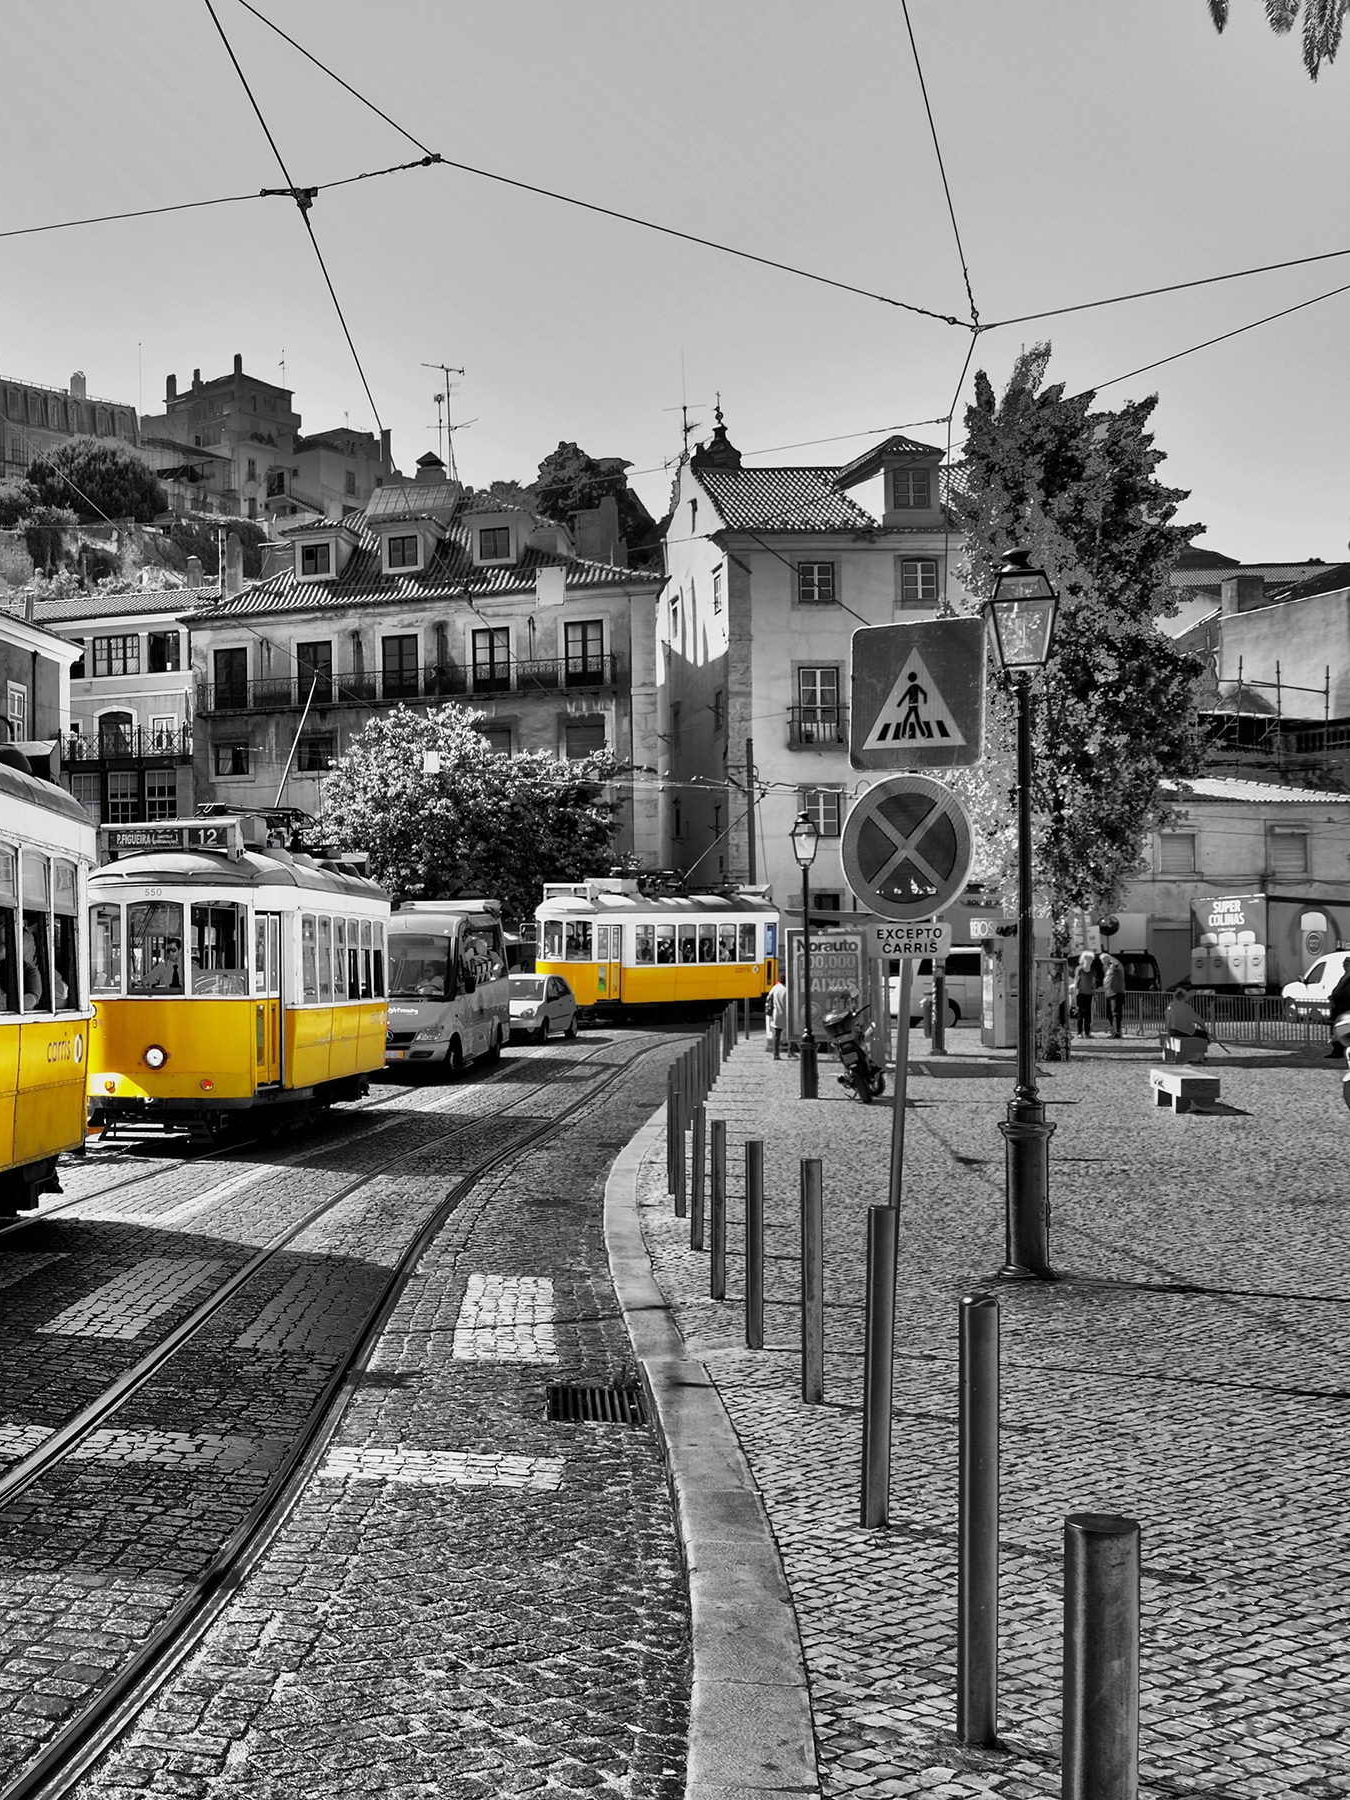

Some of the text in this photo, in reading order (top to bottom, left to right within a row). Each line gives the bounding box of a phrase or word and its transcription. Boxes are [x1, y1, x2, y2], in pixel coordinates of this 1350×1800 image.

[198, 829, 218, 844] 12
[144, 888, 162, 896] 550
[1212, 900, 1242, 913] SUPER
[1208, 912, 1245, 926] COLINAS
[877, 928, 942, 940] EXCEPTO
[796, 939, 859, 952] Norauto
[882, 942, 938, 954] CARRIS
[46, 1032, 71, 1063] carris
